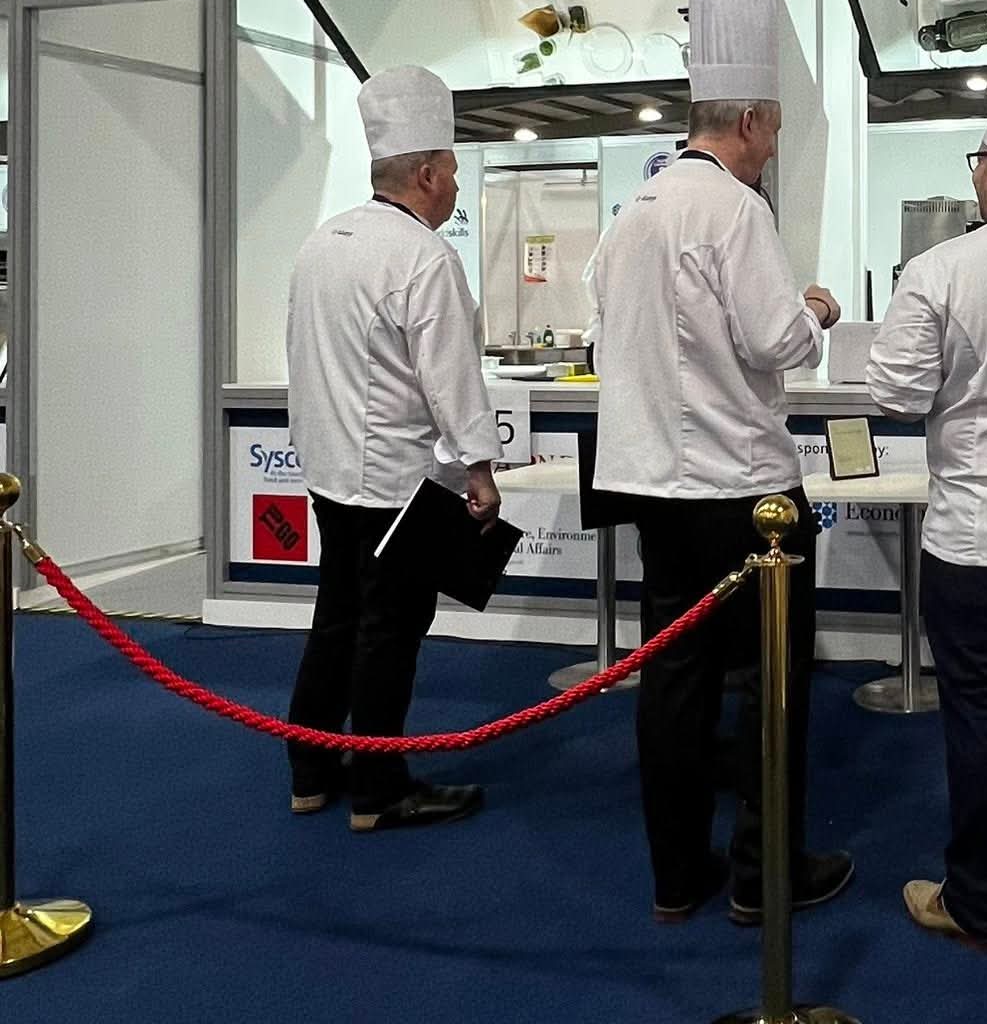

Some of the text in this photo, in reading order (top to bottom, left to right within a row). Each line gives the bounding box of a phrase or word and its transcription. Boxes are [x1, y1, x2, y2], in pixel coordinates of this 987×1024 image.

[495, 410, 515, 445] 5
[538, 527, 596, 541] Environme
[526, 542, 562, 555] Affairs
